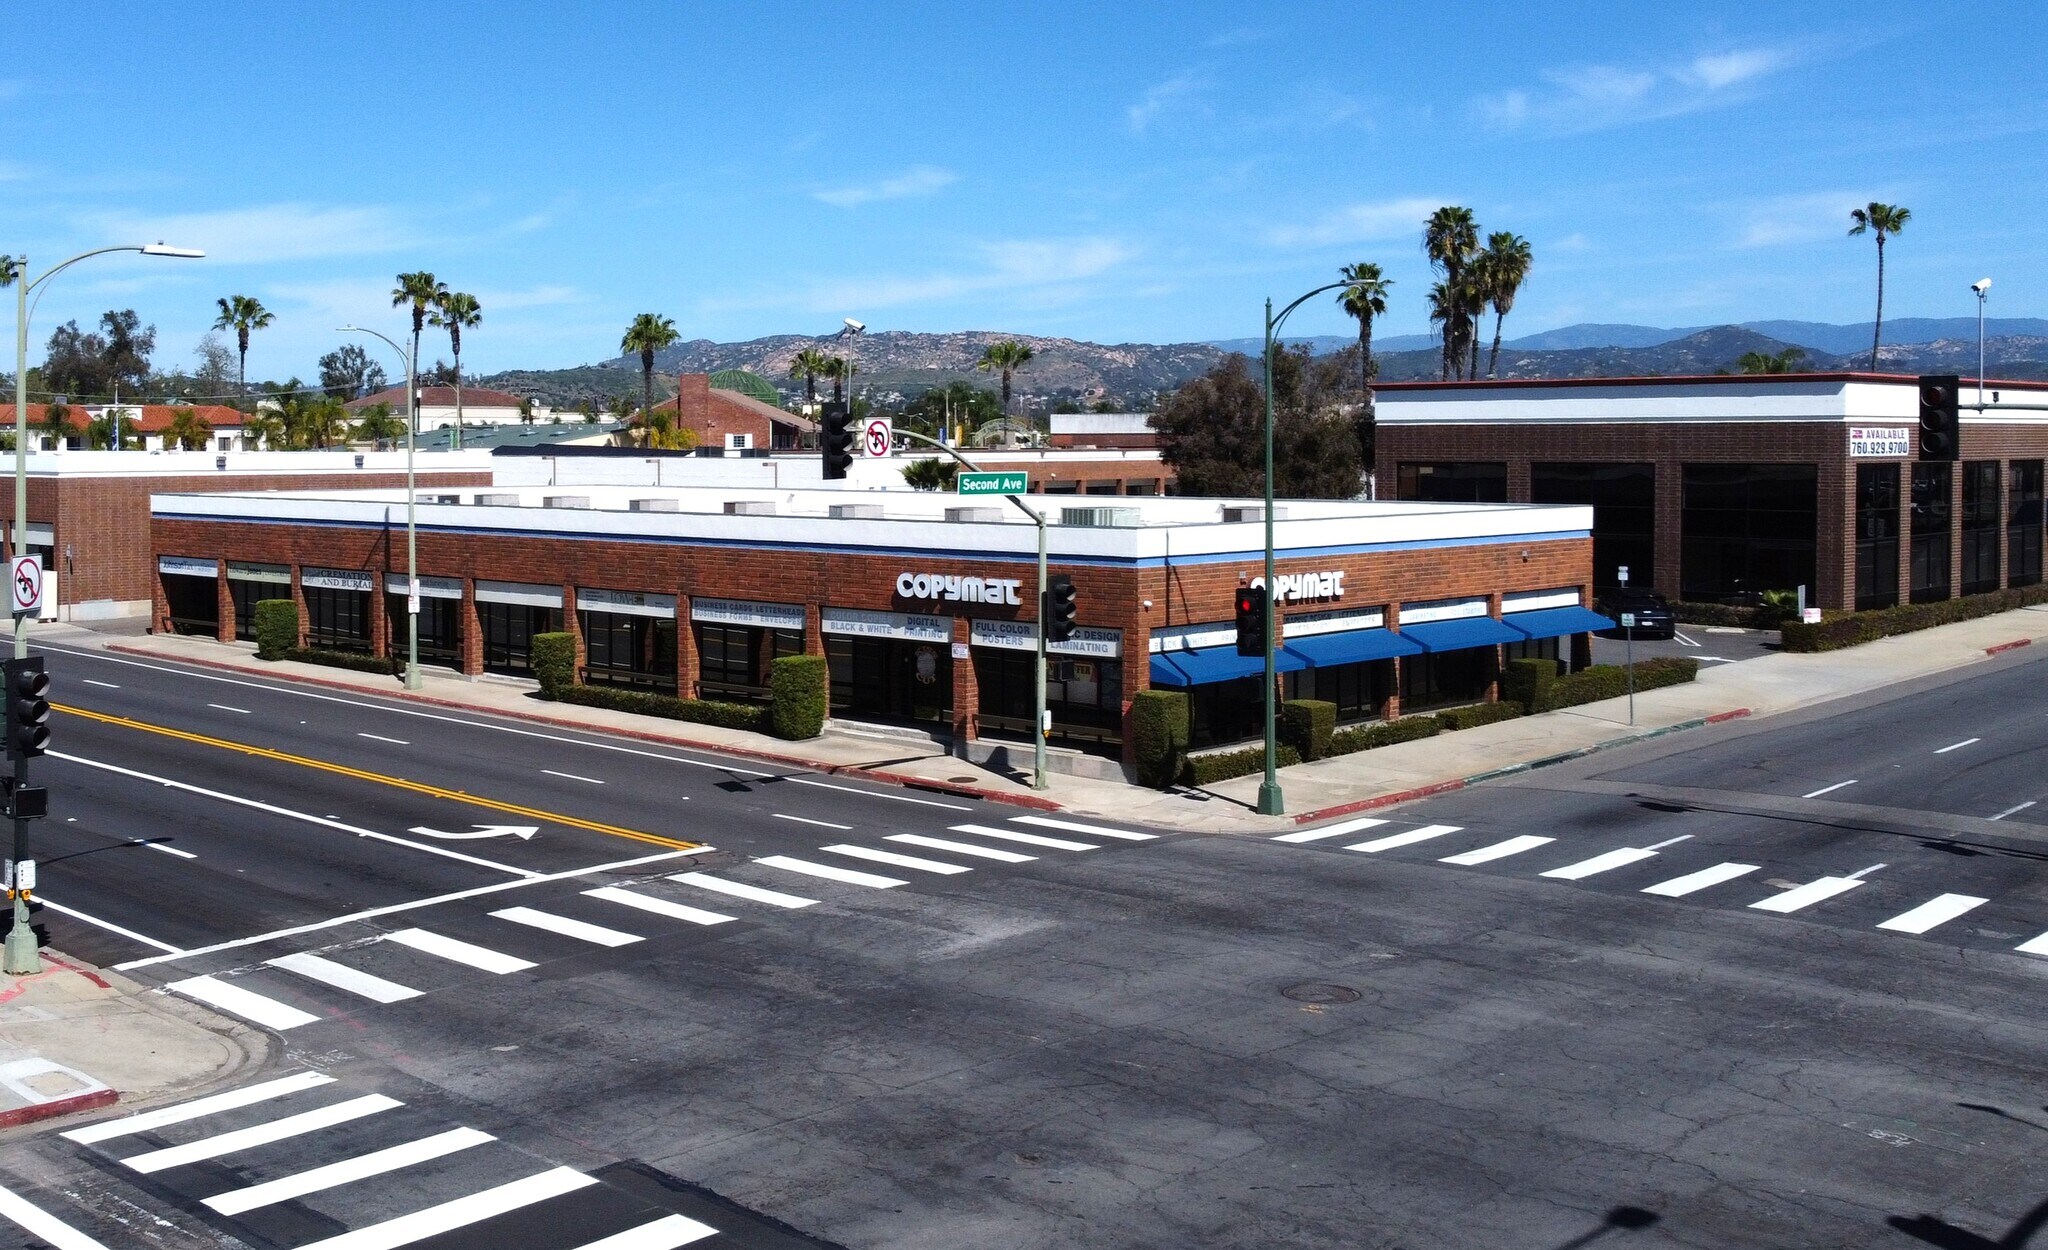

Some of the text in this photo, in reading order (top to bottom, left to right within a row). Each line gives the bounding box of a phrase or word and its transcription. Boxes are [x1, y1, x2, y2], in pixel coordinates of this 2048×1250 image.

[1866, 430, 1904, 439] AVAILABLE
[1851, 442, 1907, 454] 760.929.9700
[963, 478, 1022, 491] Second Ave
[320, 570, 373, 581] CREMATION
[321, 578, 372, 589] AND BURIAL
[694, 600, 805, 616] BUSINESS CARDS LETTERHEADS
[694, 610, 801, 626] BUSINESS FORMS ENVELOPES
[907, 617, 940, 627] DIGITAL
[830, 622, 943, 638] BLACK & WHITE PRINTING
[976, 622, 1030, 634] FULL COLOR
[982, 635, 1023, 646] POSTERS
[1085, 630, 1120, 641] DESIGN
[1050, 641, 1108, 652] LAMINATING
[1154, 639, 1177, 650] BACK
